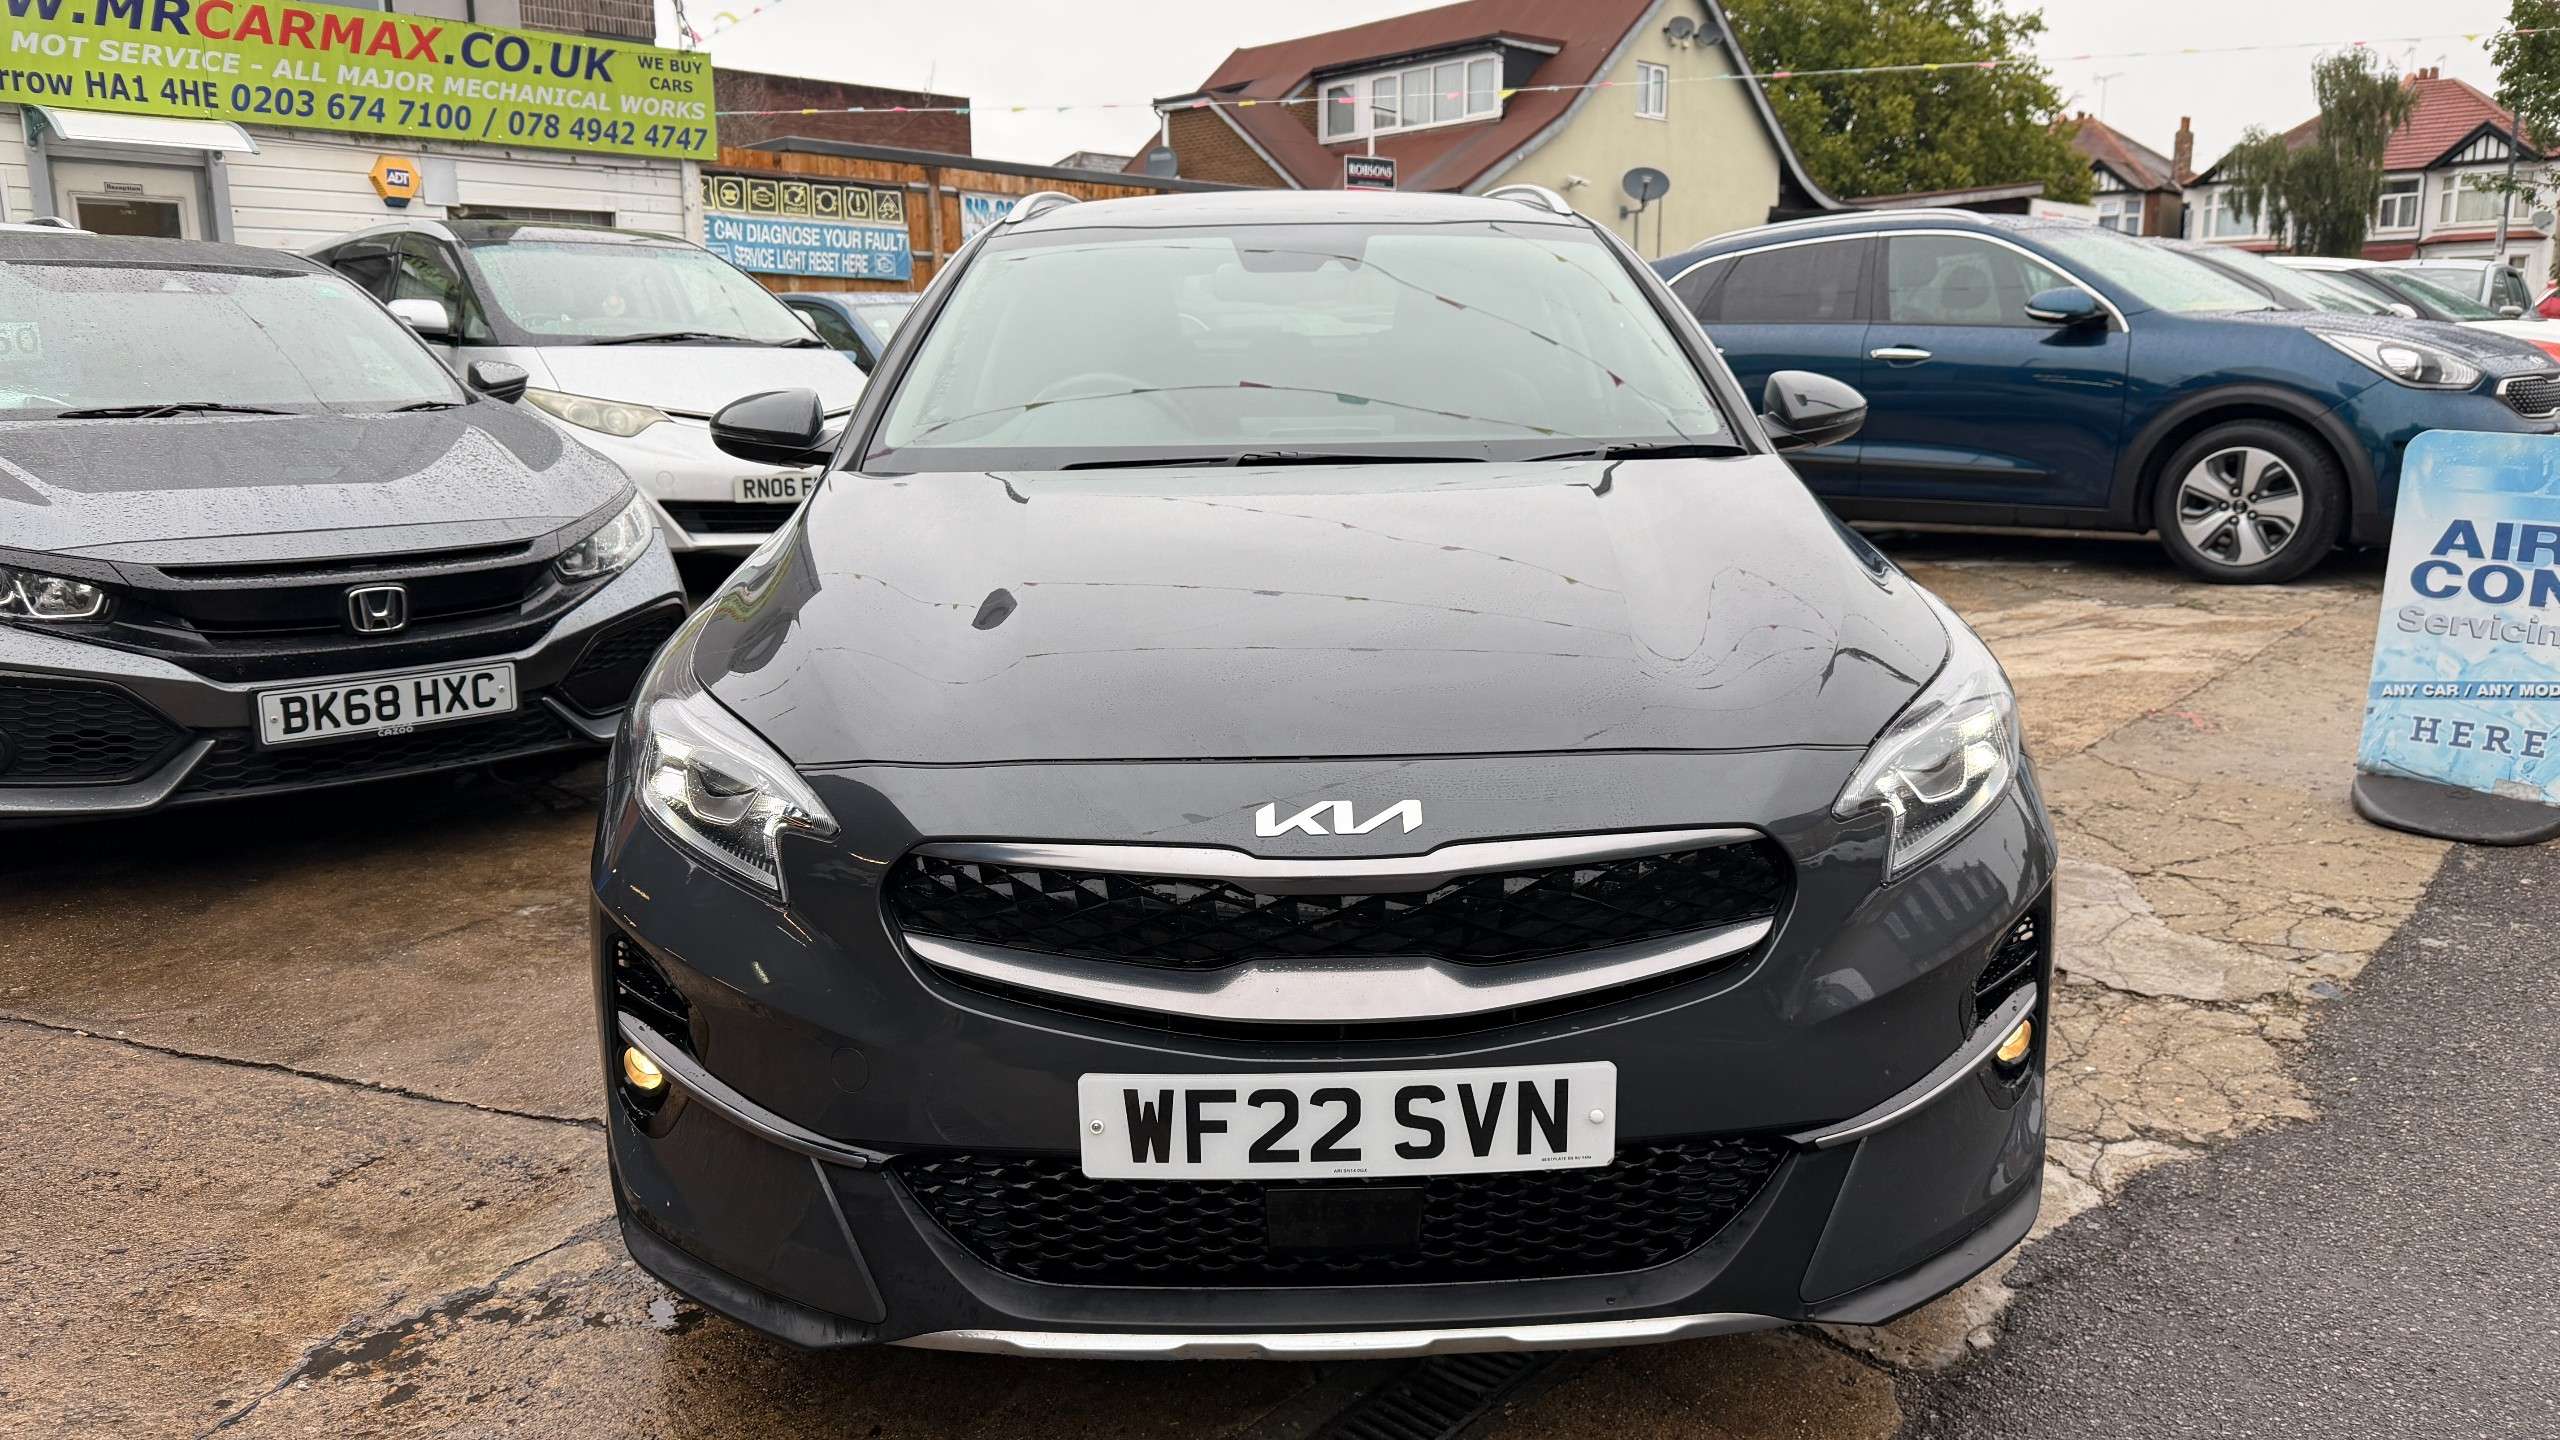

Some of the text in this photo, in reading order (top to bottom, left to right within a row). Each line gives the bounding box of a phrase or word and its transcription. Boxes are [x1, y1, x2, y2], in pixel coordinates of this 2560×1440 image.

[11, 30, 89, 58] MOT
[98, 39, 241, 74] SERVICE
[272, 58, 328, 83] ALL
[337, 65, 434, 95] MAJOR
[443, 76, 611, 112] MECHANICAL
[620, 95, 706, 121] WORKS
[637, 55, 703, 75] WE BUY
[649, 77, 693, 93] CARS
[85, 70, 149, 103] HA1
[160, 77, 219, 109] 4HE
[231, 83, 314, 117] 0203
[327, 93, 386, 123] 674
[398, 100, 472, 131] 7100
[481, 108, 498, 138] /
[508, 110, 560, 139] 078
[569, 117, 636, 145] 4942
[644, 126, 708, 151] 4747
[388, 171, 409, 185] ADT
[714, 220, 743, 241] CAN
[746, 224, 820, 247] DIAGNOSE
[824, 230, 862, 249] YOUR
[734, 244, 868, 274] SERVICE LIGHT RESET HERE
[743, 478, 819, 499] RN06 F
[2430, 519, 2560, 564] AIR
[279, 672, 496, 735] BK68 HXC
[2382, 684, 2416, 697] ANY
[2422, 684, 2460, 697] CAR
[2464, 683, 2473, 697] /
[2477, 684, 2513, 697] ANY
[2409, 716, 2548, 759] HERE
[1255, 799, 1422, 837] KIA
[1123, 1078, 1570, 1164] WF22 SVN
